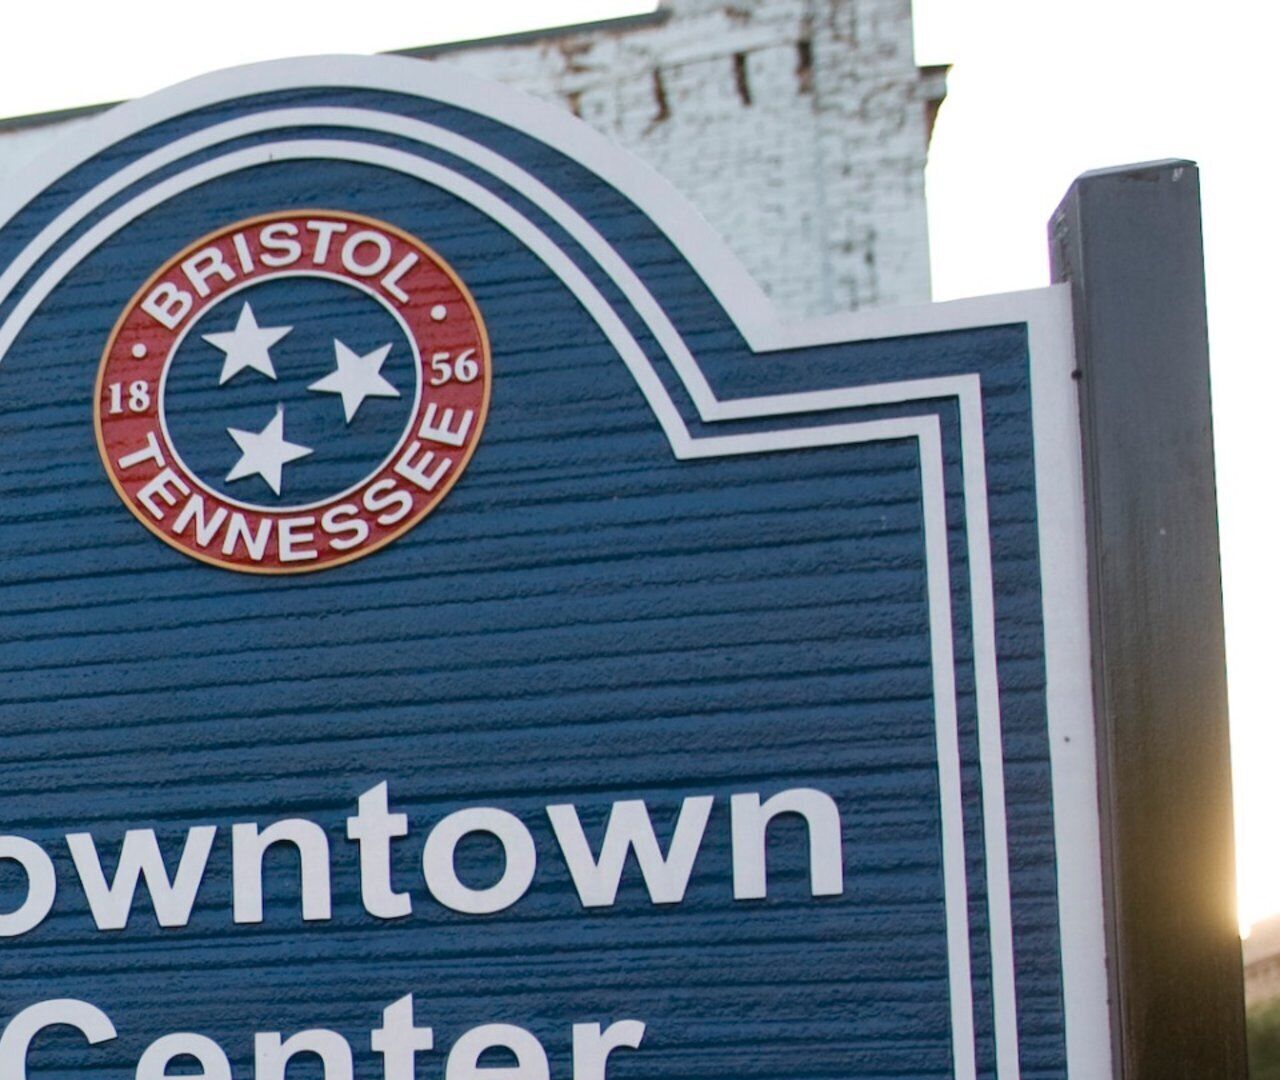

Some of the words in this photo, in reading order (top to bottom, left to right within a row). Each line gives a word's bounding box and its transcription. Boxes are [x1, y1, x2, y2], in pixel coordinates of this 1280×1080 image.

[140, 219, 419, 331] BRISTOL
[107, 380, 150, 414] 18
[430, 348, 479, 386] 56
[117, 401, 474, 562] TENNESSEE
